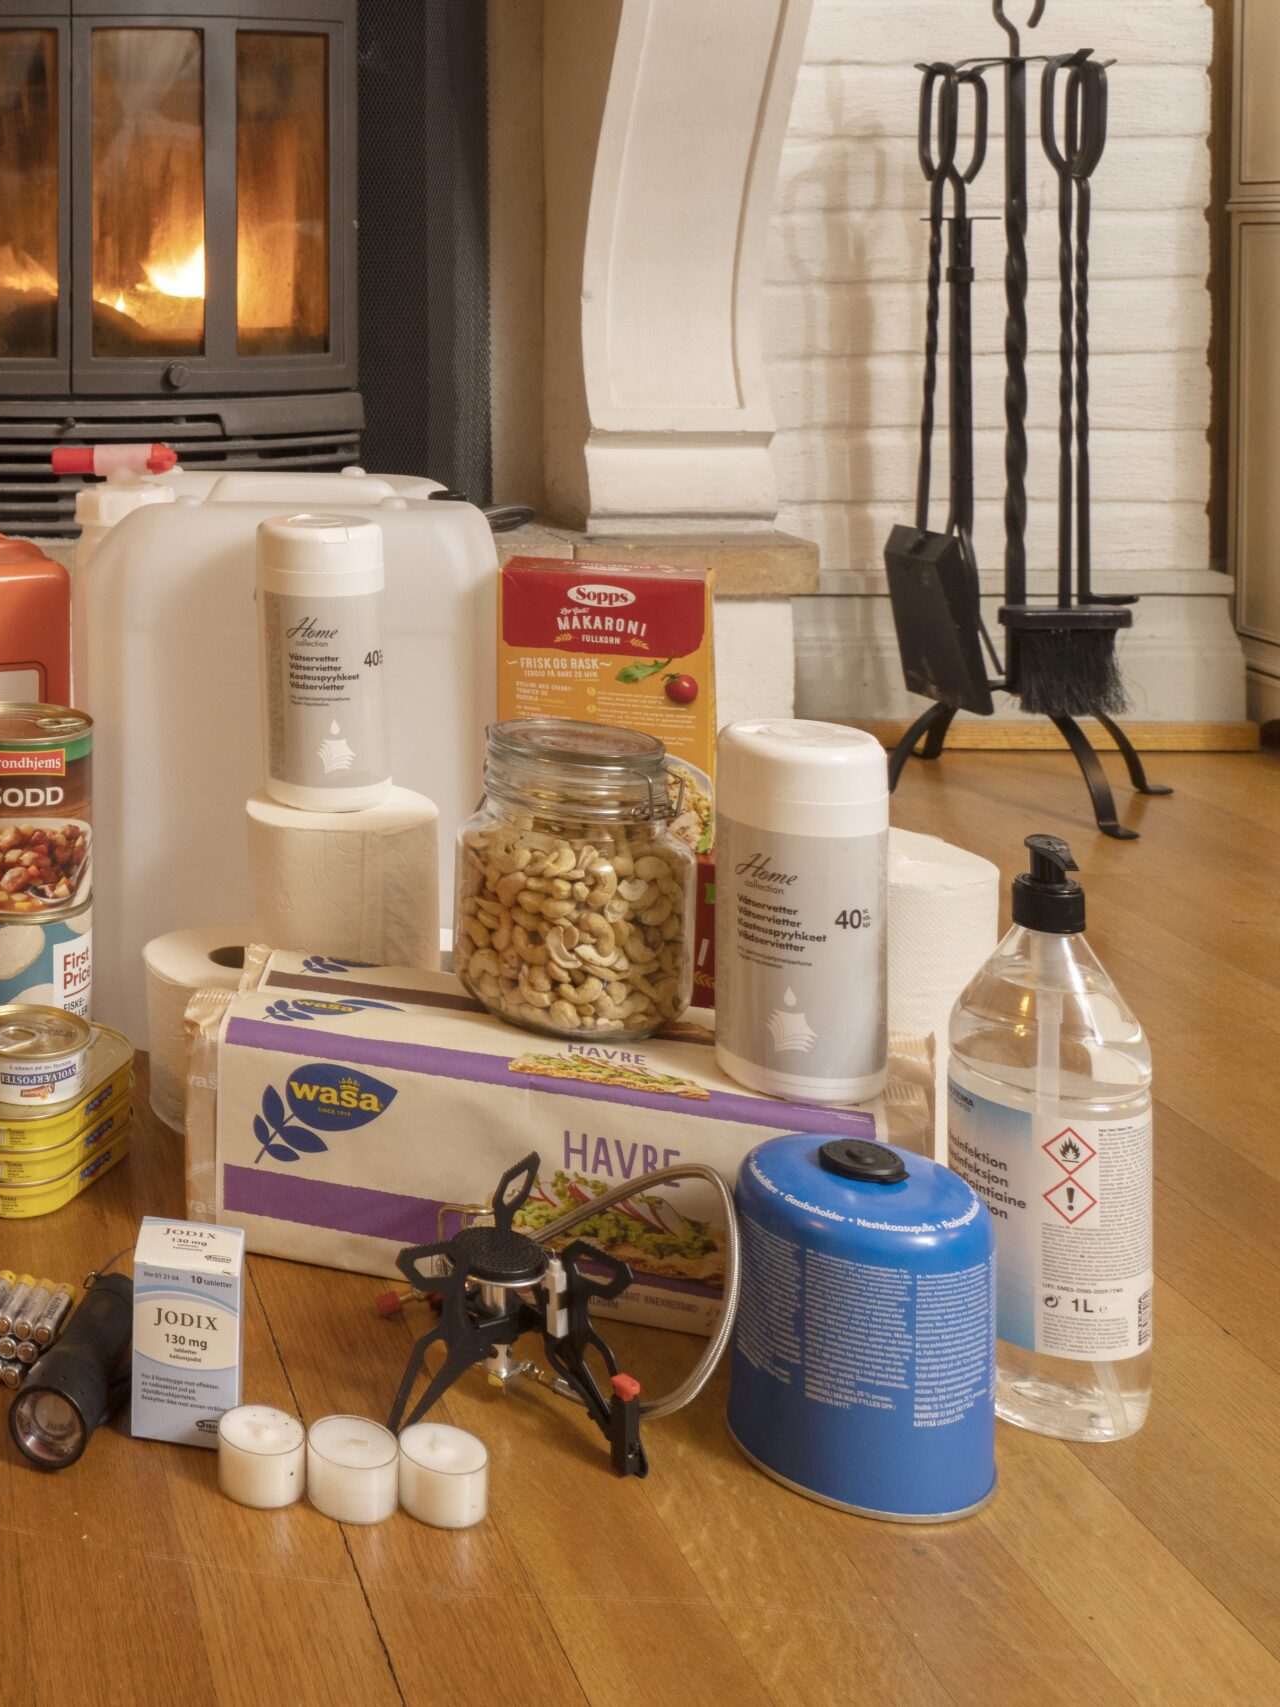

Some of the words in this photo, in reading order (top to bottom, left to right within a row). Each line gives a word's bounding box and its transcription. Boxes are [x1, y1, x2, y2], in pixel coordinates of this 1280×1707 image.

[575, 587, 629, 606] Sopps
[286, 616, 338, 639] Home
[556, 616, 647, 637] MAKARONI
[581, 634, 620, 645] FULLKORN
[364, 650, 379, 667] 40
[520, 658, 552, 669] FRISK
[553, 658, 567, 669] OG
[571, 658, 599, 669] RASK
[289, 672, 360, 683] Kosteuspyyhkeet
[734, 853, 798, 887] Home
[744, 879, 784, 895] collection
[835, 909, 862, 930] 40
[737, 918, 827, 942] Kosteuspyyhkeet
[63, 946, 89, 971] First
[63, 965, 91, 990] Price
[63, 997, 85, 1011] FISKE-
[296, 999, 353, 1013] wasa
[568, 1044, 647, 1067] HAVRE
[1, 1064, 77, 1085] SVOLVÆRPOSTEI
[290, 1081, 381, 1112] wasa
[564, 1130, 680, 1188] HAVRE
[784, 1194, 846, 1222] Gassbeholder
[856, 1217, 936, 1234] Nestekaasupullo
[163, 1228, 216, 1239] JODIX
[190, 1275, 203, 1284] 10
[203, 1279, 232, 1288] tabletter
[153, 1307, 219, 1331] JODIX
[164, 1333, 185, 1345] 130
[189, 1338, 207, 1351] mg
[174, 1347, 197, 1355] tabletter
[169, 1353, 201, 1363] kaliumjodid
[149, 1382, 178, 1391] radioaktivt
[155, 1375, 183, 1385] forebygge
[196, 1382, 219, 1390] effekten
